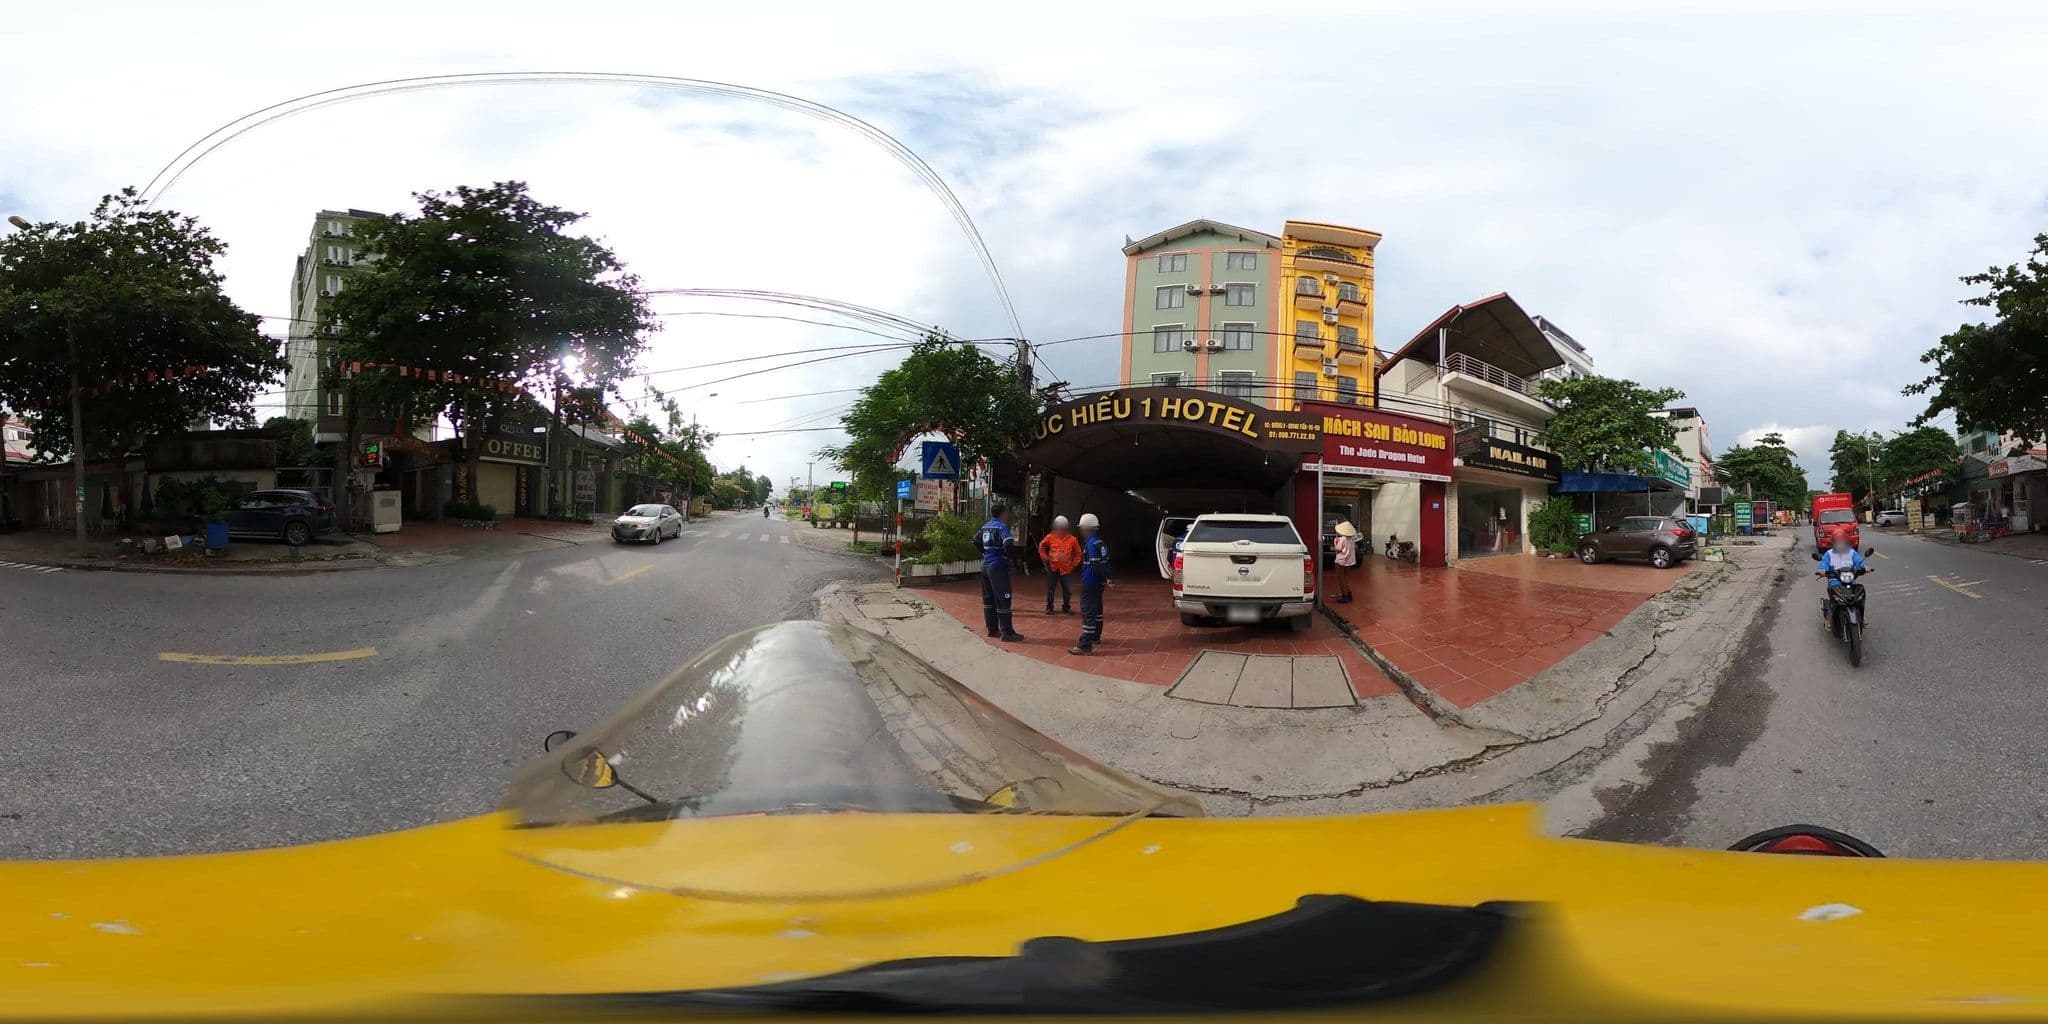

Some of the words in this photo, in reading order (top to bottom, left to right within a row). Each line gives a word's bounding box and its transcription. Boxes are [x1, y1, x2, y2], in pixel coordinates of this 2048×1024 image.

[1071, 390, 1131, 427] HIẾU
[1140, 398, 1151, 418] 1
[1160, 397, 1258, 439] HOTEL
[1323, 414, 1361, 437] HÁCH
[1363, 424, 1390, 443] SẠN
[1392, 423, 1418, 445] BẢO
[1418, 431, 1446, 450] LONG
[486, 438, 542, 459] OFFEE
[1339, 445, 1355, 456] The
[1356, 447, 1377, 459] Jade
[1378, 450, 1407, 462] Dragon
[1407, 453, 1426, 465] Hotel
[1490, 446, 1525, 465] NAIL
